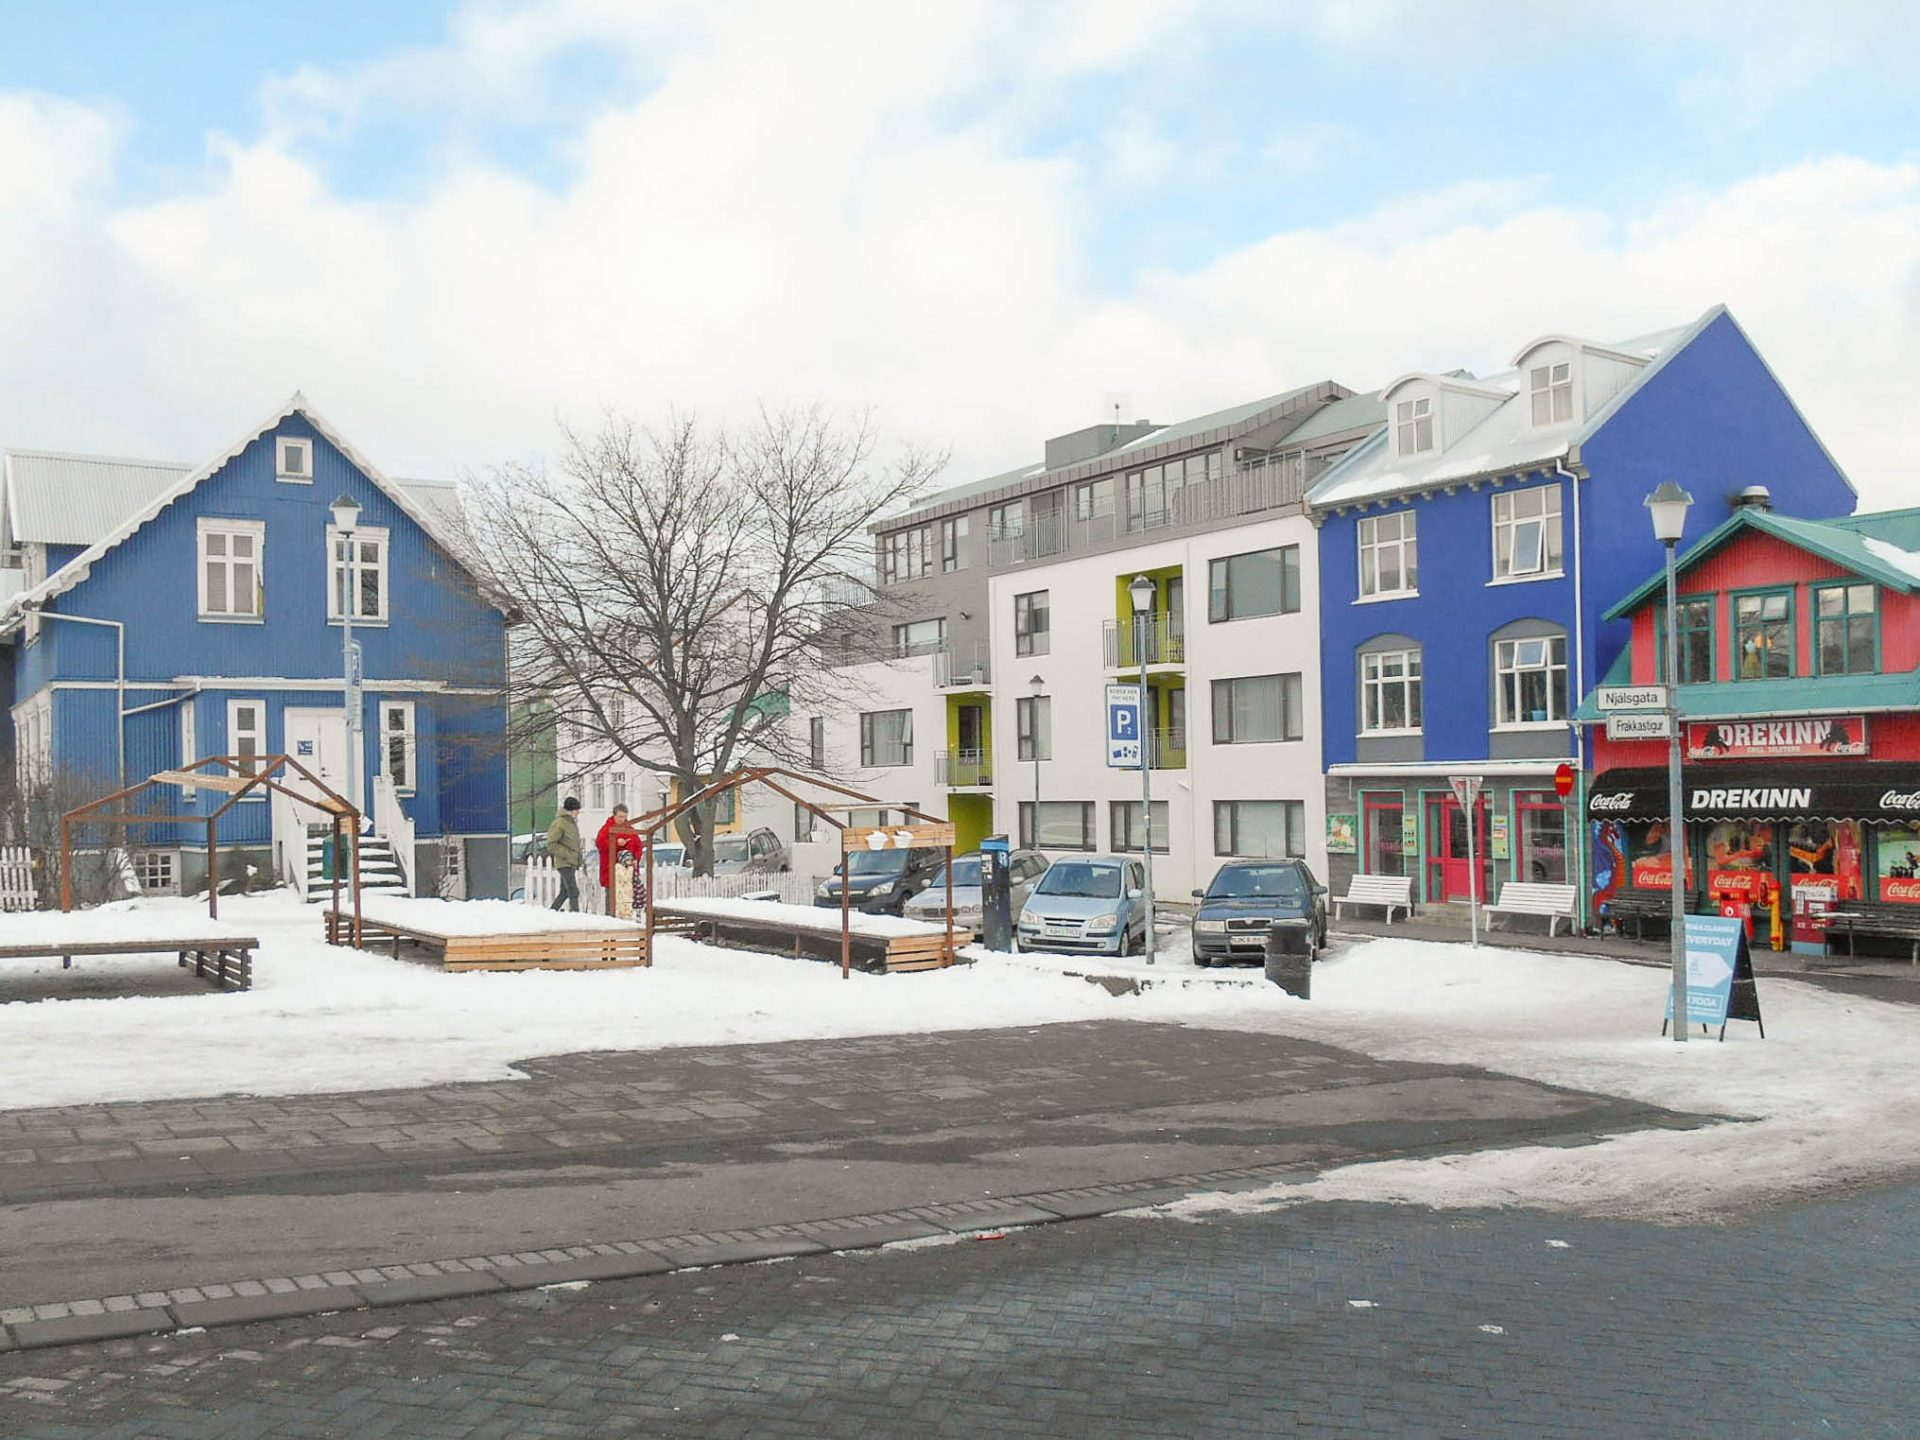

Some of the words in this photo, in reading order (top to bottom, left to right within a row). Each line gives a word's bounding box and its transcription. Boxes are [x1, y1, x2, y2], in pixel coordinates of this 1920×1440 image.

[1718, 720, 1832, 746] DREKINN
[1590, 793, 1634, 810] Coca-Cola
[1691, 788, 1811, 809] DREKINN
